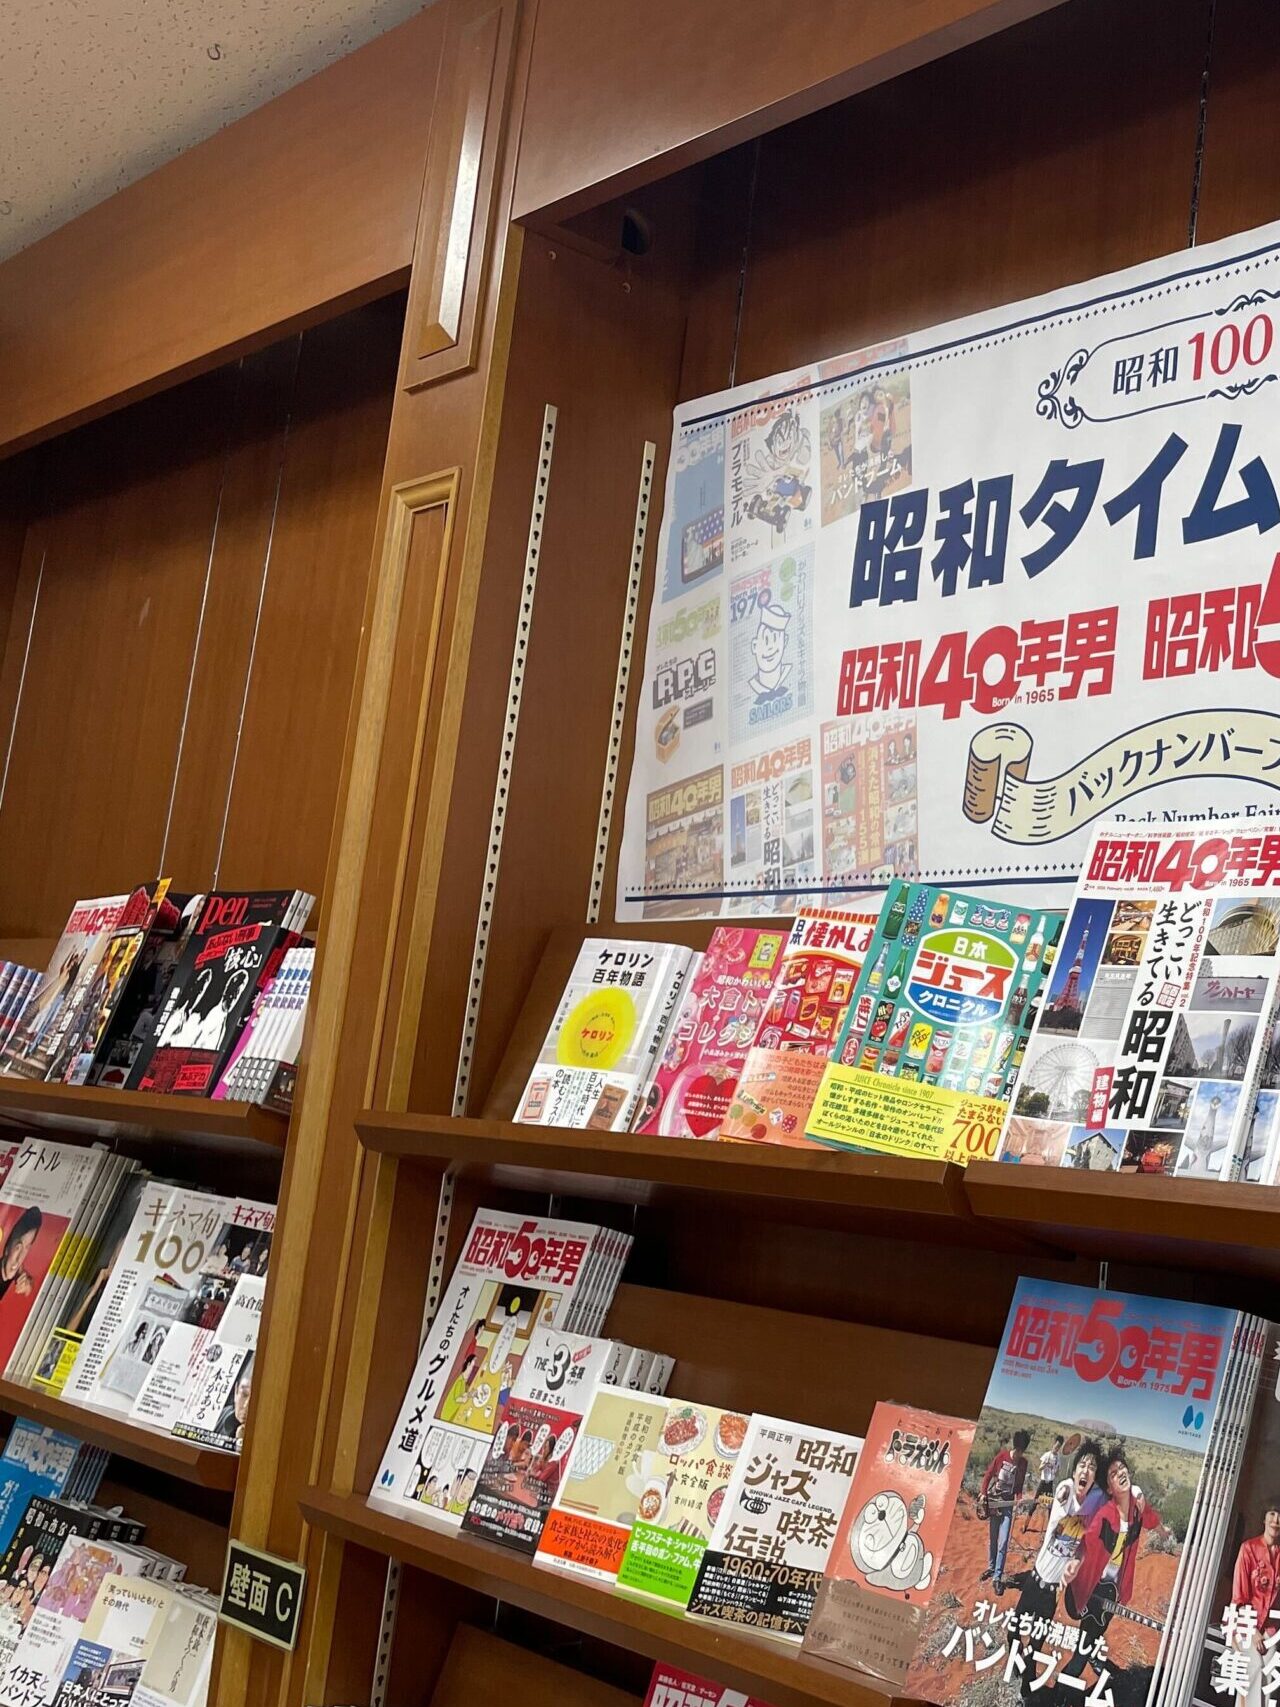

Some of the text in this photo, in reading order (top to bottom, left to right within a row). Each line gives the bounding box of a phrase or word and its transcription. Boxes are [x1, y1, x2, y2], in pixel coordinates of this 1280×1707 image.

[653, 648, 717, 710] RPG
[836, 606, 1119, 721] 昭和40年男
[749, 695, 793, 726] SAILORS
[1025, 689, 1055, 705] 1965
[1229, 878, 1250, 888] 1965
[197, 895, 250, 936] pen
[790, 921, 805, 945] 日本
[598, 949, 654, 968] ケロリン
[953, 936, 988, 960] 日本
[1137, 900, 1178, 1007] 生きてる
[1164, 900, 1201, 979] どっこい
[591, 968, 647, 987] 百年物語
[911, 950, 1013, 1001] ジュース
[918, 989, 988, 1015] クロニクル
[580, 1027, 615, 1041] ケロリン
[1108, 1010, 1173, 1120] 昭和
[919, 1087, 935, 1100] 1907
[18, 1143, 61, 1172] ケトル
[950, 1119, 1002, 1156] 700
[134, 1230, 206, 1275] 100
[464, 1221, 588, 1286] 昭和50年男
[439, 1286, 471, 1352] オレたちの
[533, 1356, 550, 1373] THE
[545, 1343, 571, 1391] 3
[1006, 1299, 1223, 1401] 昭和50年男
[398, 1353, 450, 1454] グルメ道
[1150, 1381, 1171, 1392] 1975
[758, 1426, 793, 1445] 平岡正明
[668, 1452, 735, 1482] ロッパ食談
[743, 1453, 818, 1501] ジャズ
[795, 1438, 859, 1477] 昭和
[749, 1488, 833, 1514] SHOWA JAZZ CAFE LEGEND
[724, 1523, 787, 1566] 伝説
[777, 1510, 839, 1550] 喫茶
[228, 1563, 293, 1622] 壁面 C
[972, 1598, 1109, 1662] オレたちが沸騰した
[1214, 1602, 1259, 1697] 特集
[940, 1623, 1115, 1707] バンドブーム
